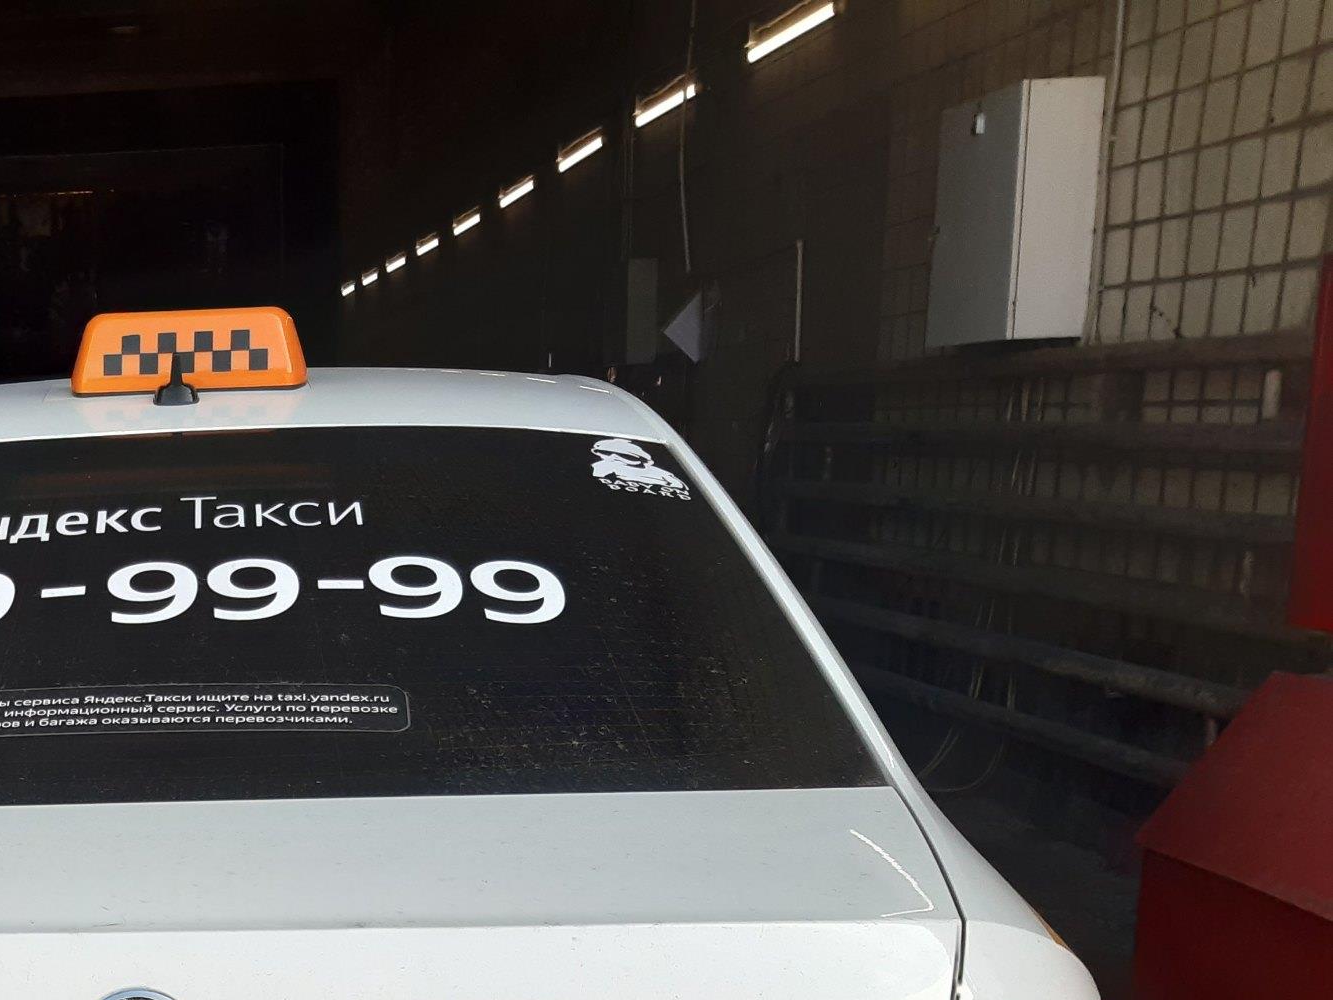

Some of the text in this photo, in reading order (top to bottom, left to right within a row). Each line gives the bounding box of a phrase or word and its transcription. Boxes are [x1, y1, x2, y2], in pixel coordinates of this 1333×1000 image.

[180, 494, 365, 531] Такси
[14, 696, 80, 708] сервиса
[84, 693, 192, 705] Яндекс.Такси
[197, 693, 250, 704] ищите
[256, 694, 274, 702] на
[277, 693, 390, 704] taxi.yandex.ru
[4, 704, 154, 719] информационный
[157, 704, 220, 714] сервис.
[224, 703, 282, 714] Услуги
[286, 704, 306, 713] по
[310, 704, 399, 715] перевозке
[38, 716, 98, 727] багажа
[101, 715, 211, 726] оказываются
[215, 715, 353, 725] перевозчиками.
